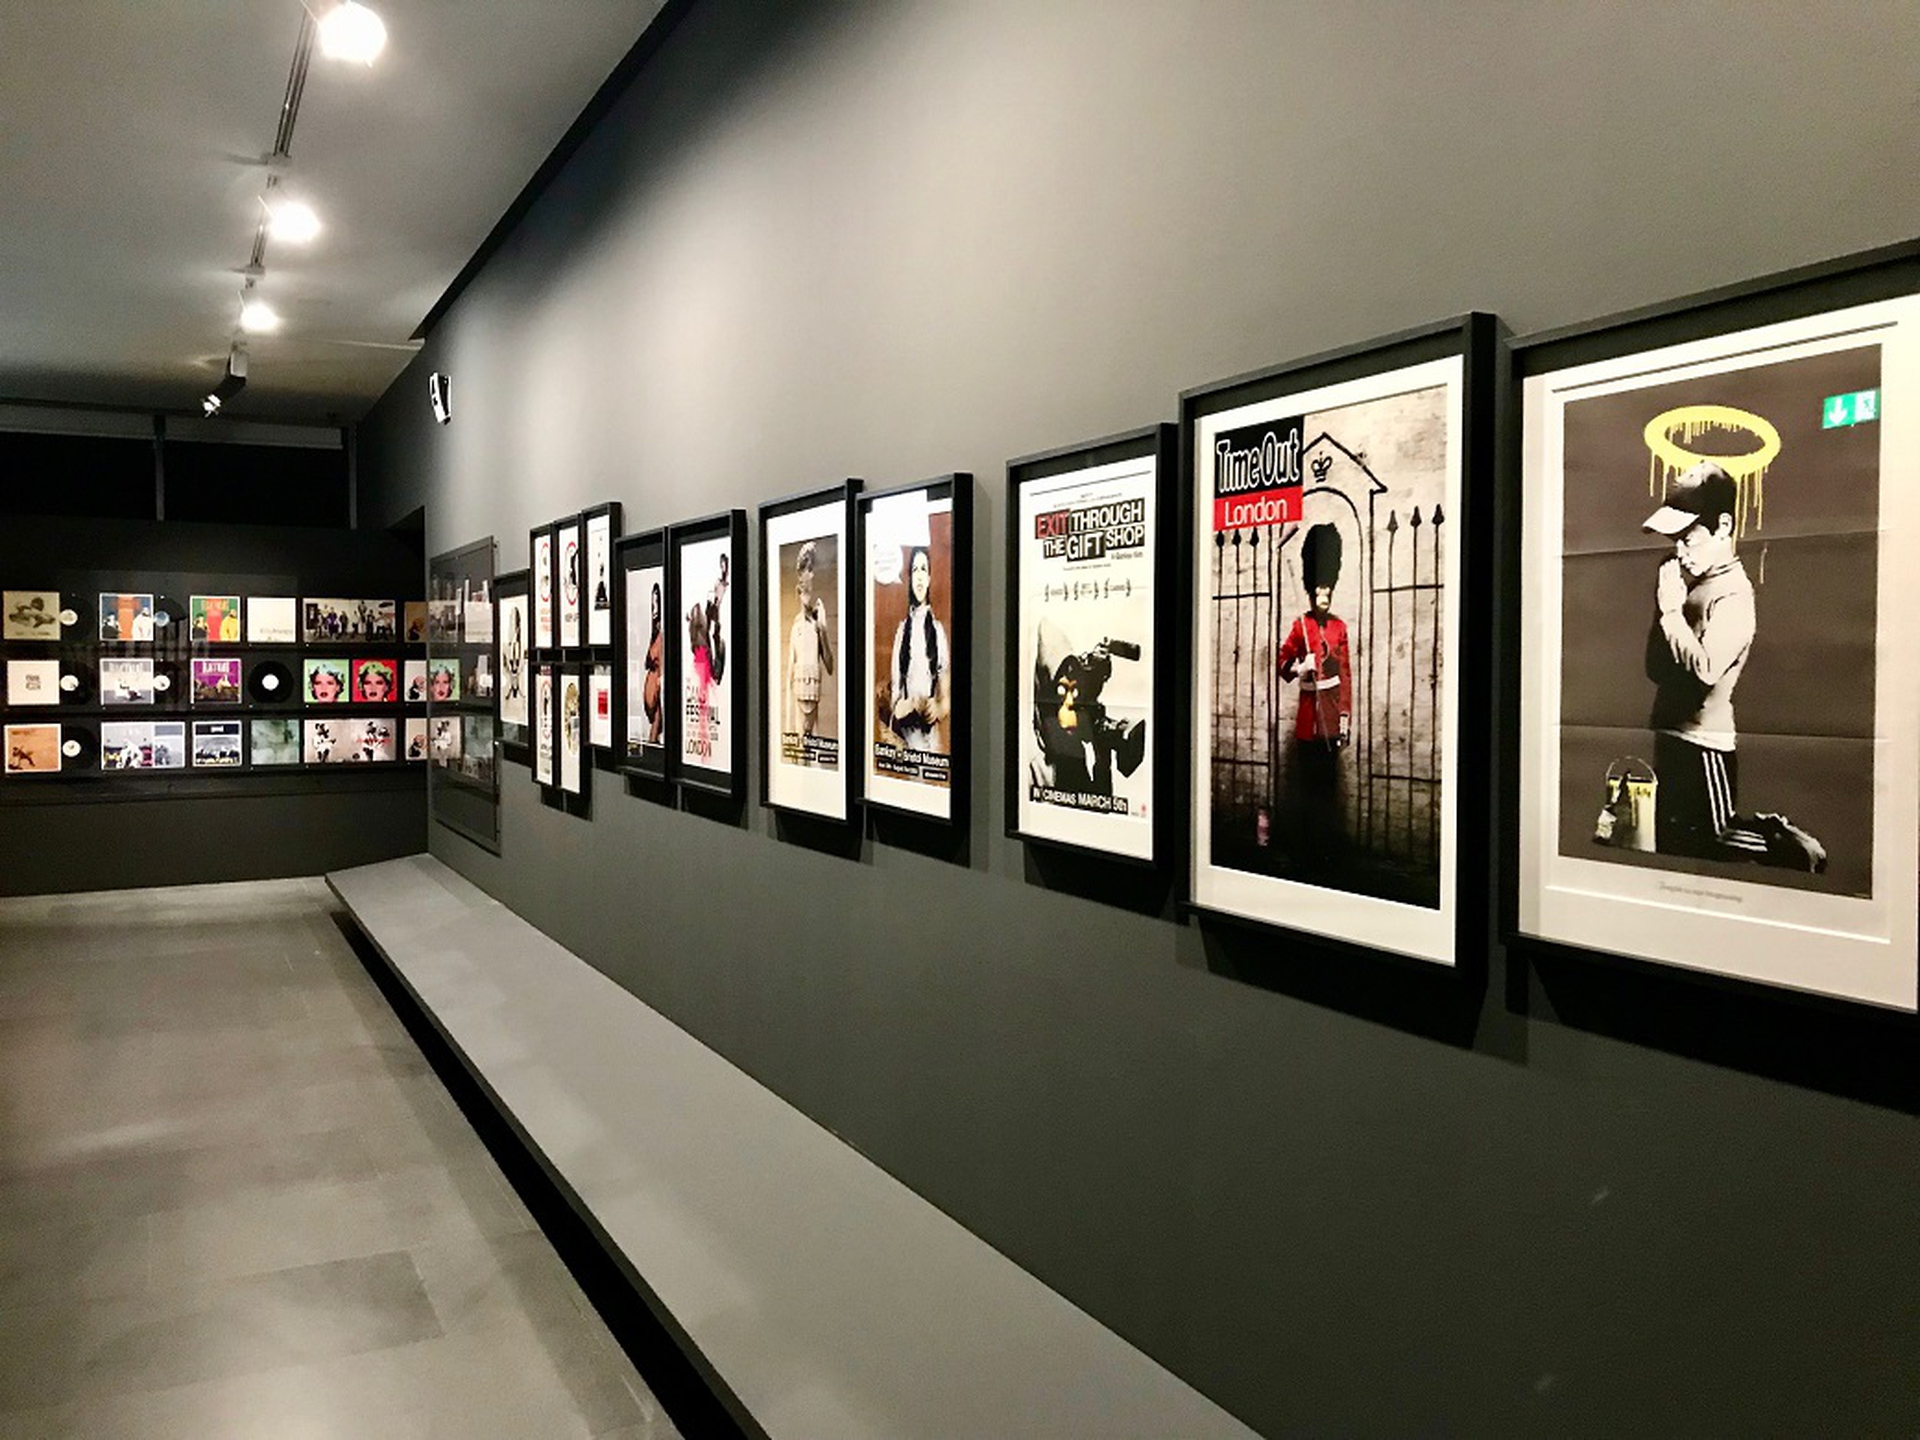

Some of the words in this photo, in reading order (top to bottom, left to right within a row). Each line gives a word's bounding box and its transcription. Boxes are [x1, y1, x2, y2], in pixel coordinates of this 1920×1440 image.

[1036, 510, 1069, 539] EXIT
[1072, 500, 1143, 532] THROUGH
[1225, 496, 1288, 526] London
[1044, 538, 1066, 557] THE
[1067, 531, 1104, 560] GIFT
[1106, 525, 1144, 548] SHOP
